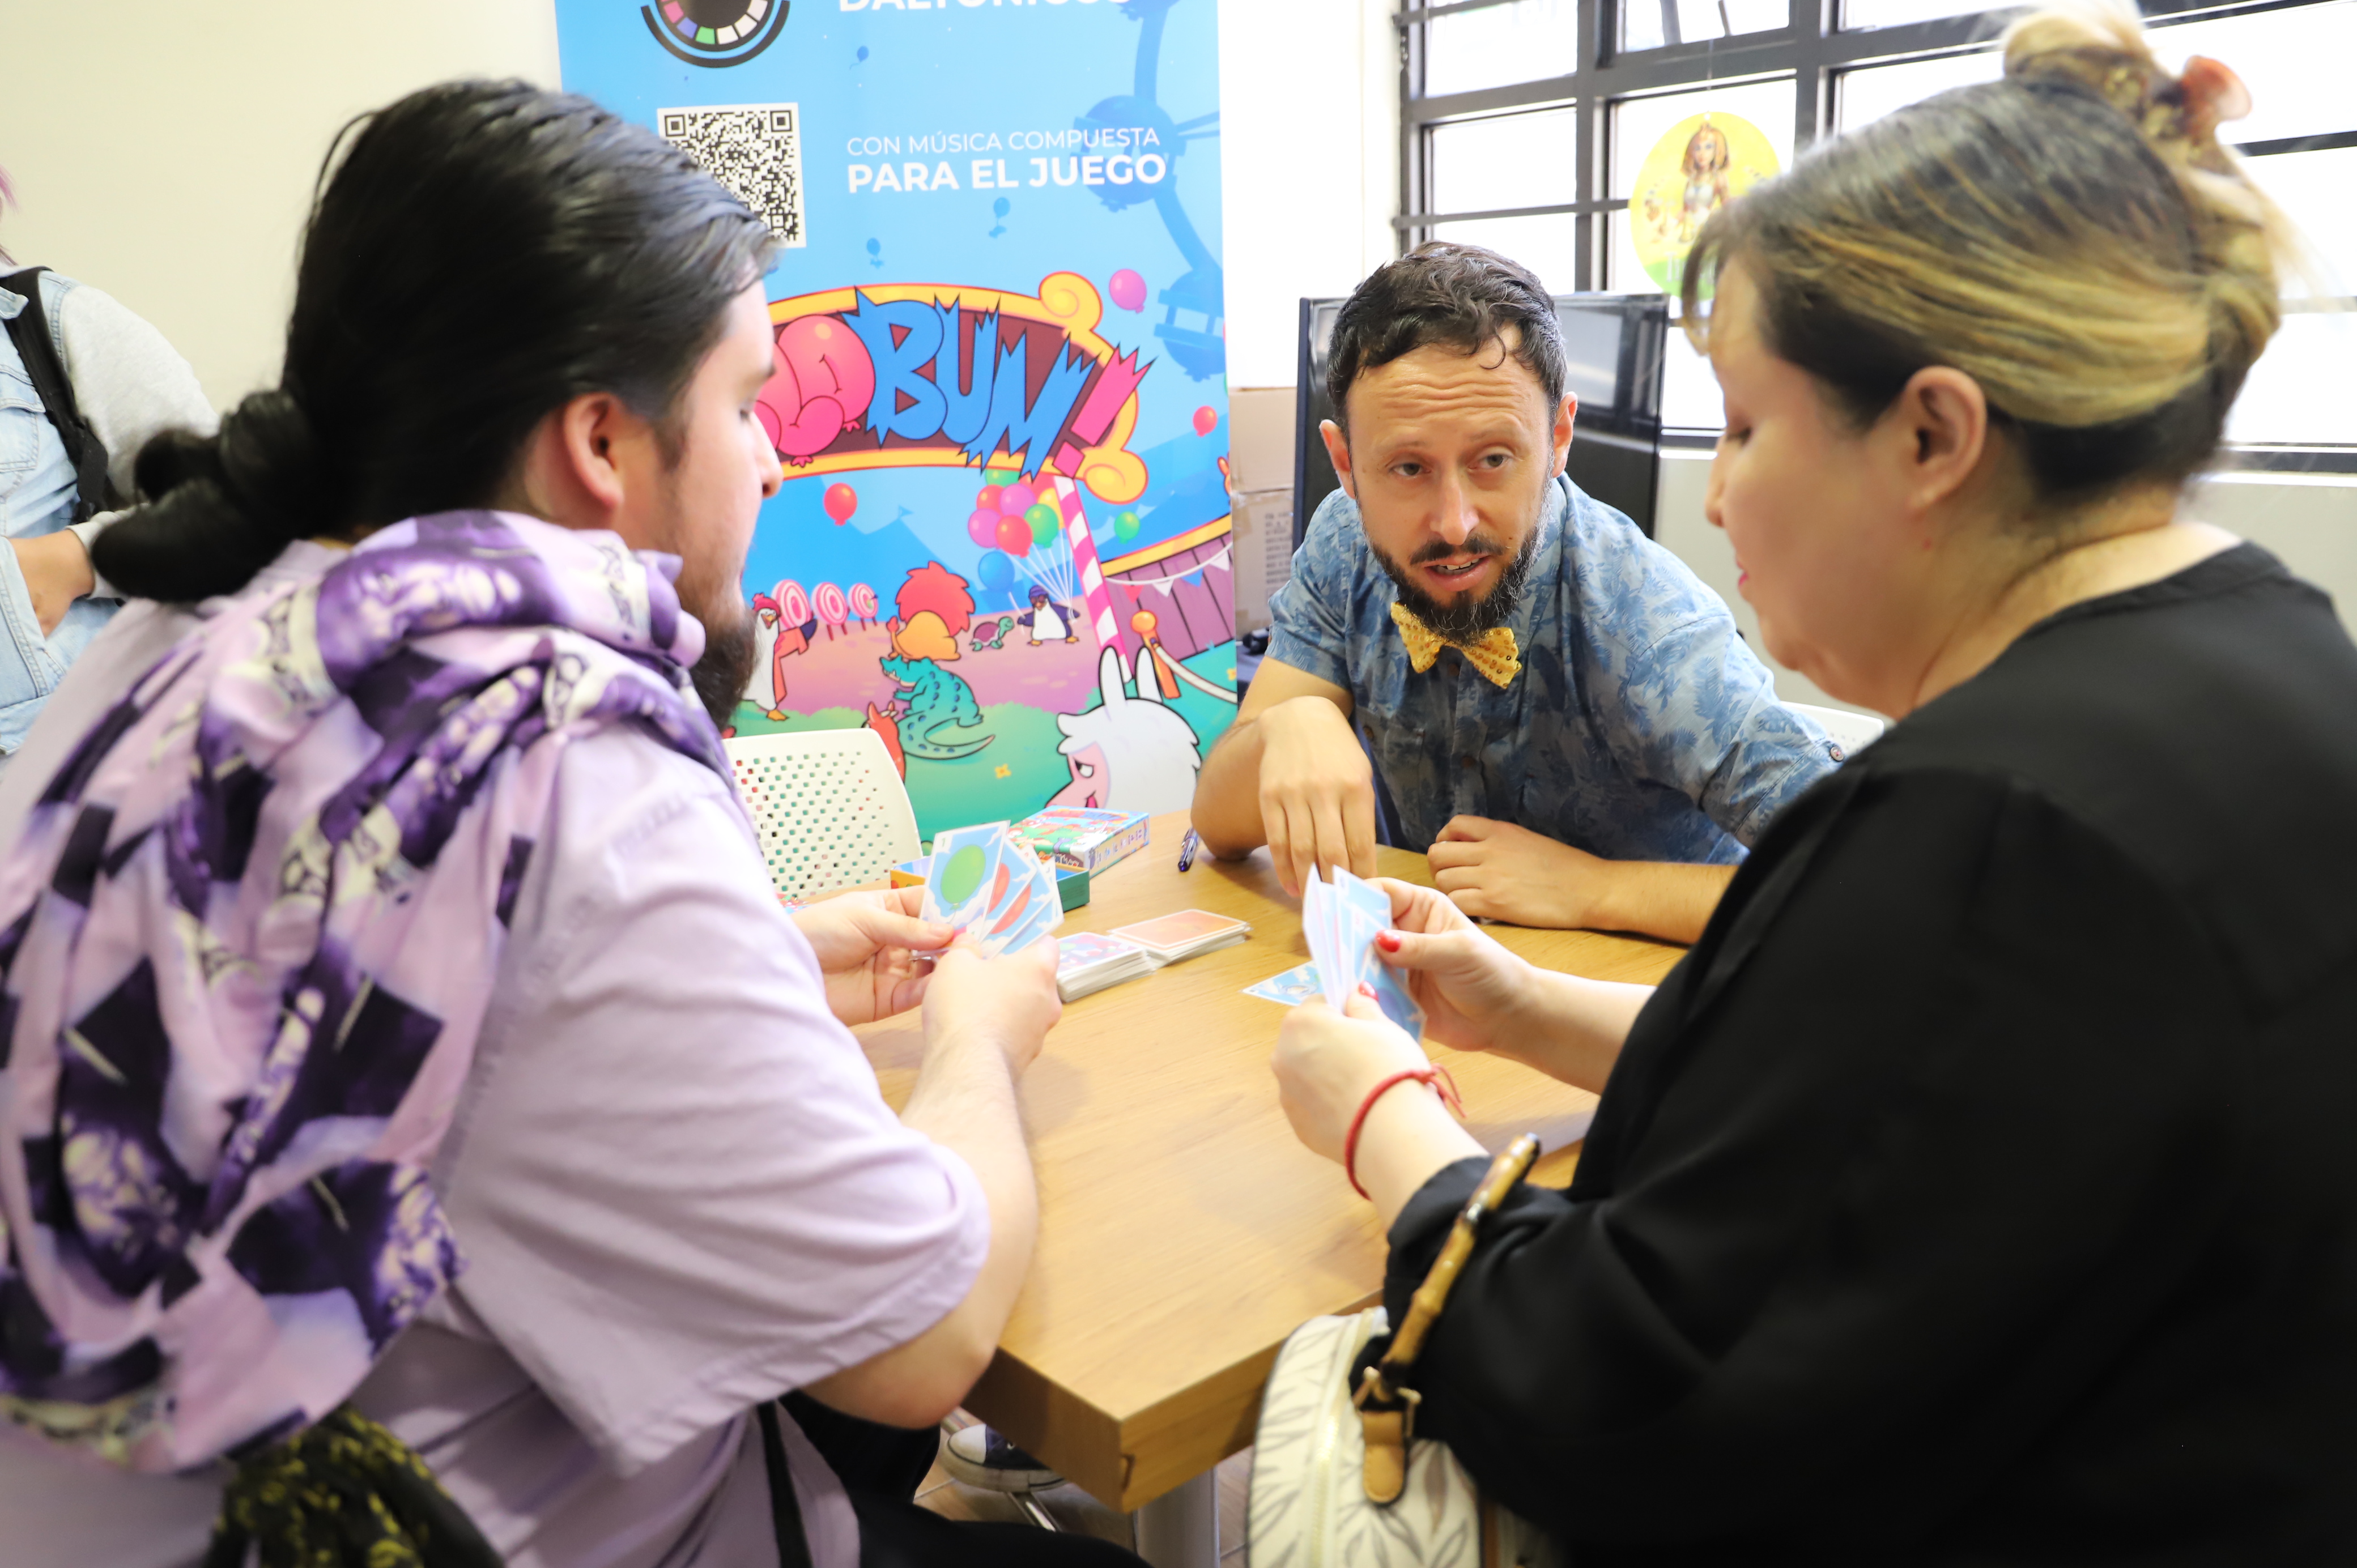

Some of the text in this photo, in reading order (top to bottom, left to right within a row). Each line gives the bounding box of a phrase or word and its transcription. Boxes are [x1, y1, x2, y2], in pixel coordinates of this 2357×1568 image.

[847, 127, 1160, 156] CON MÚSICA COMPUESTA
[848, 153, 1167, 193] PARA EL JUEGO
